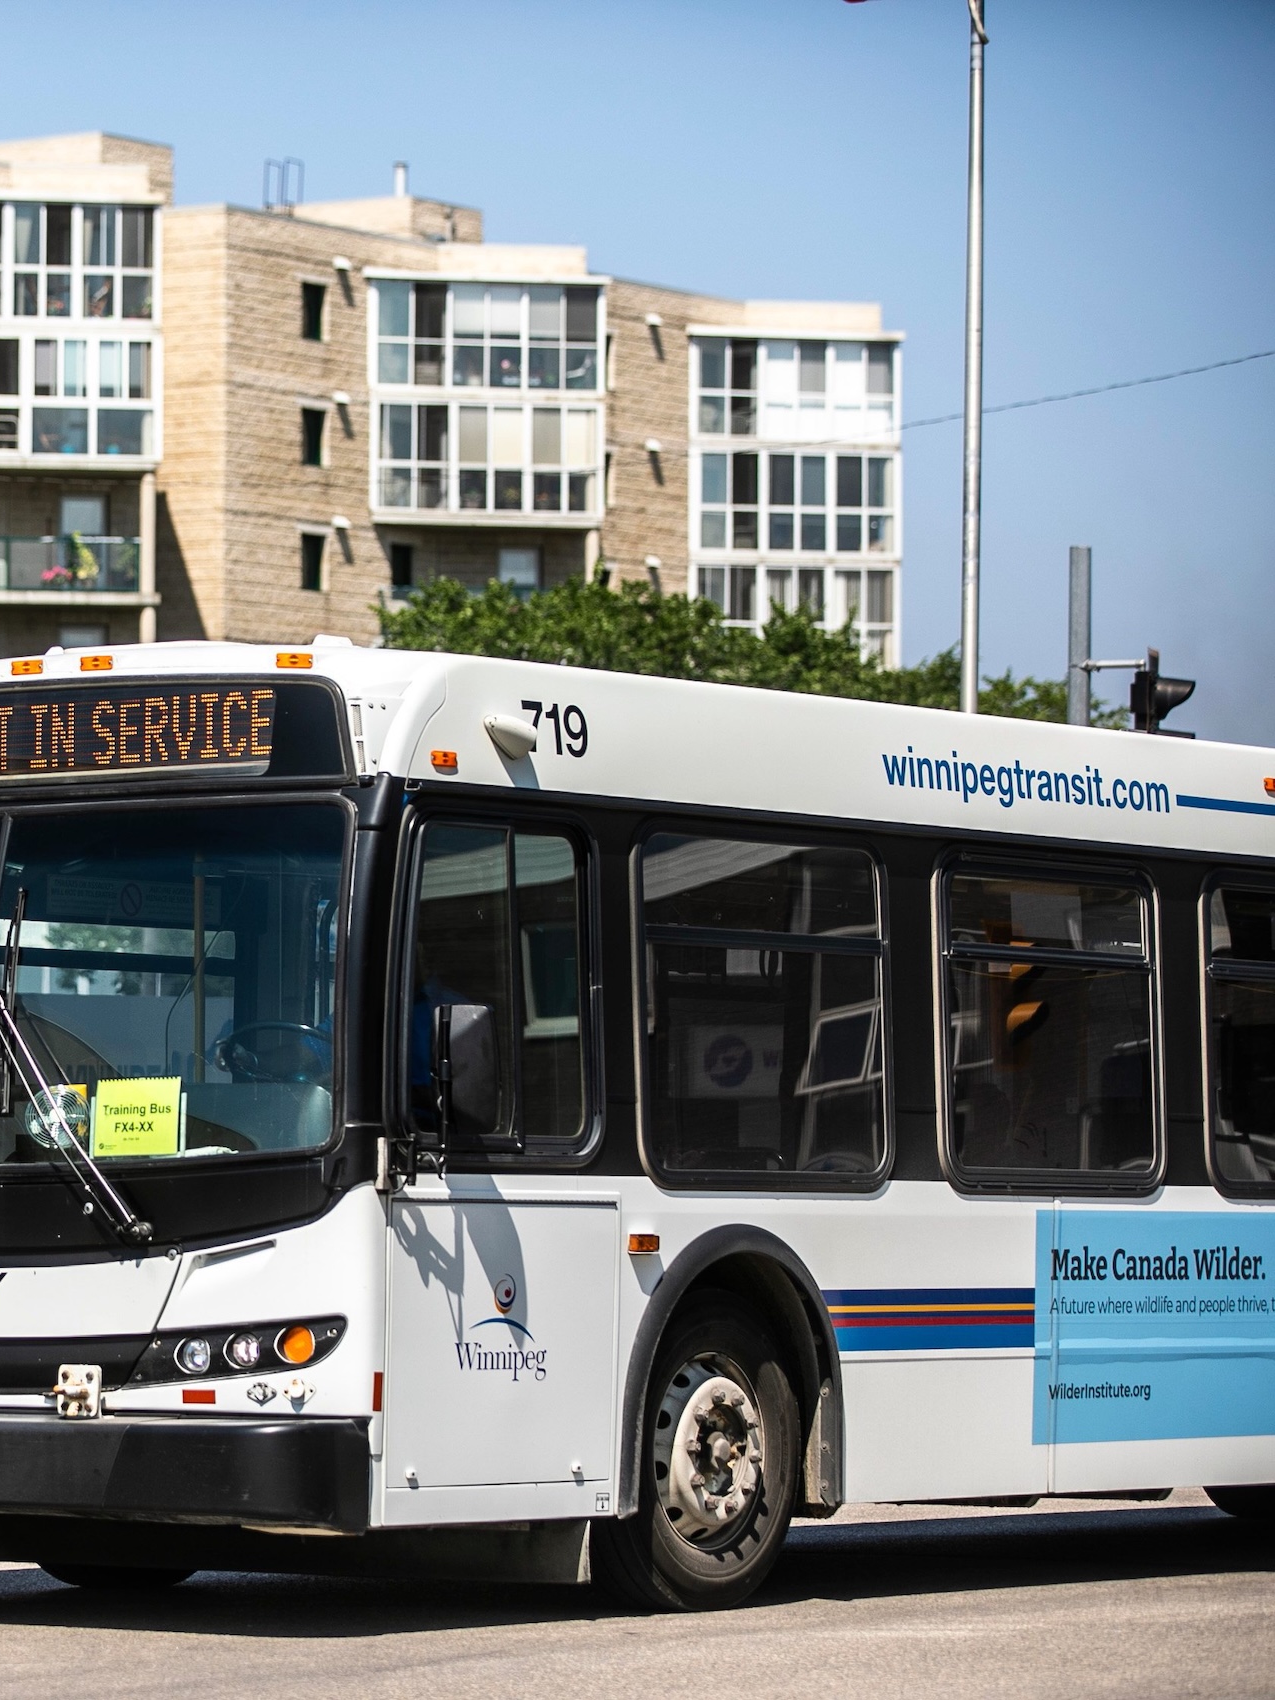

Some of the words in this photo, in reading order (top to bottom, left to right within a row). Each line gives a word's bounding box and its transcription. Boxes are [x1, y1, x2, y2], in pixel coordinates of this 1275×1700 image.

[30, 703, 75, 769] IN
[92, 689, 274, 765] SERVICE
[521, 699, 589, 758] 719
[881, 745, 1171, 814] winnipegtransit.com
[103, 1103, 146, 1117] Training
[149, 1103, 172, 1115] Bus
[114, 1121, 154, 1133] FX4-XX
[1050, 1246, 1108, 1281] Make
[1112, 1245, 1190, 1281] Canada
[1193, 1245, 1266, 1281] Wilder.
[1049, 1297, 1060, 1314] A
[1061, 1296, 1096, 1314] future
[1097, 1296, 1133, 1314] where
[1134, 1295, 1174, 1314] wildlife
[1175, 1295, 1196, 1313] and
[1199, 1294, 1235, 1317] people
[1237, 1294, 1269, 1315] thrive,
[454, 1341, 547, 1382] Winnipeg
[1048, 1381, 1151, 1401] WilderInstitute.org
